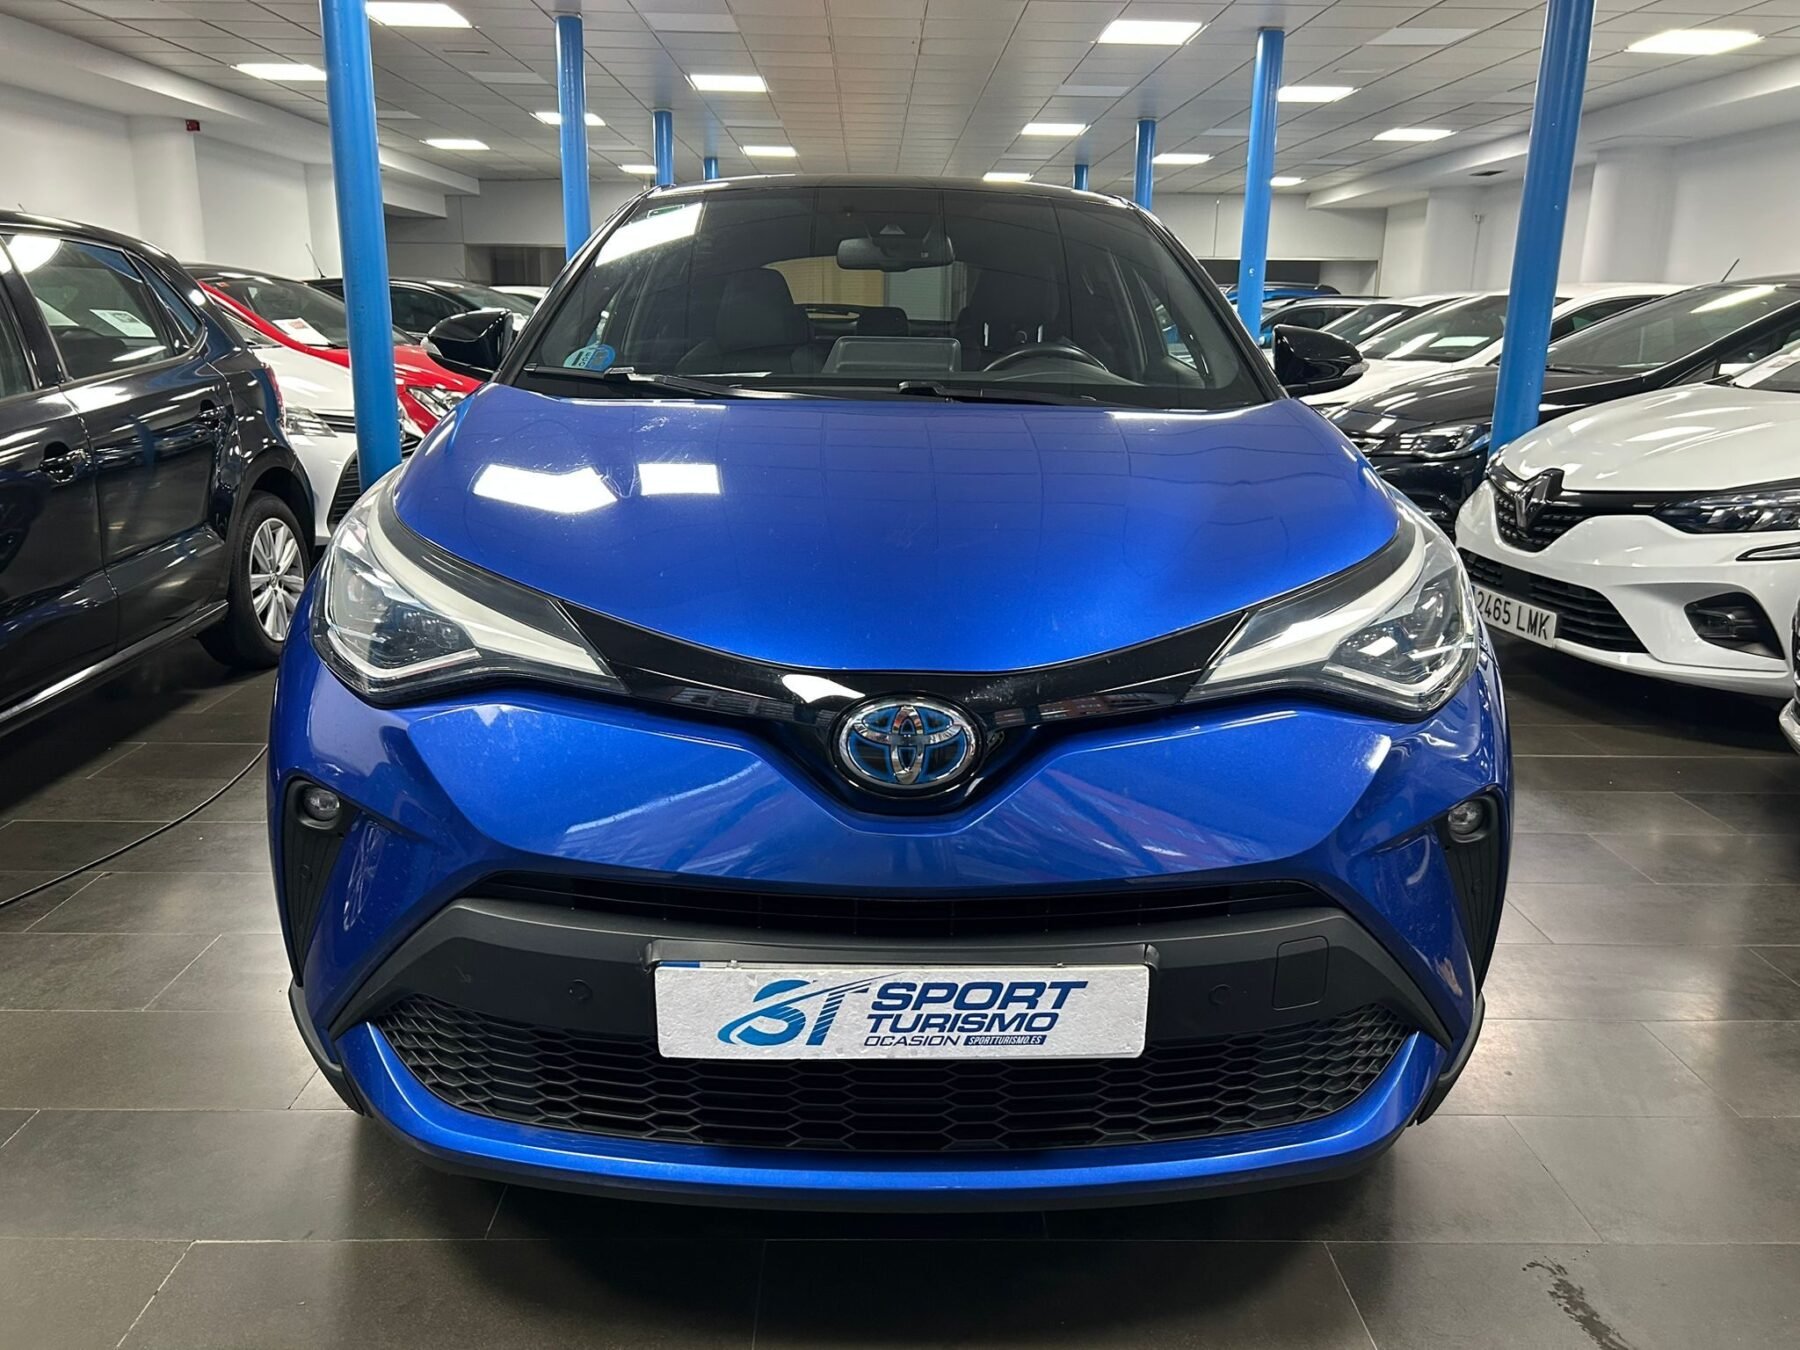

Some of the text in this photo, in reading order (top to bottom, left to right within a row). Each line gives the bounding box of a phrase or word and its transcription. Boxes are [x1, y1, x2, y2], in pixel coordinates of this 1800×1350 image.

[1477, 591, 1550, 640] 2465 LMK
[871, 981, 1089, 1011] SPORT
[866, 1012, 1060, 1034] TURISMO
[863, 1035, 1042, 1047] OCASION SPORTTURISMO.ES
